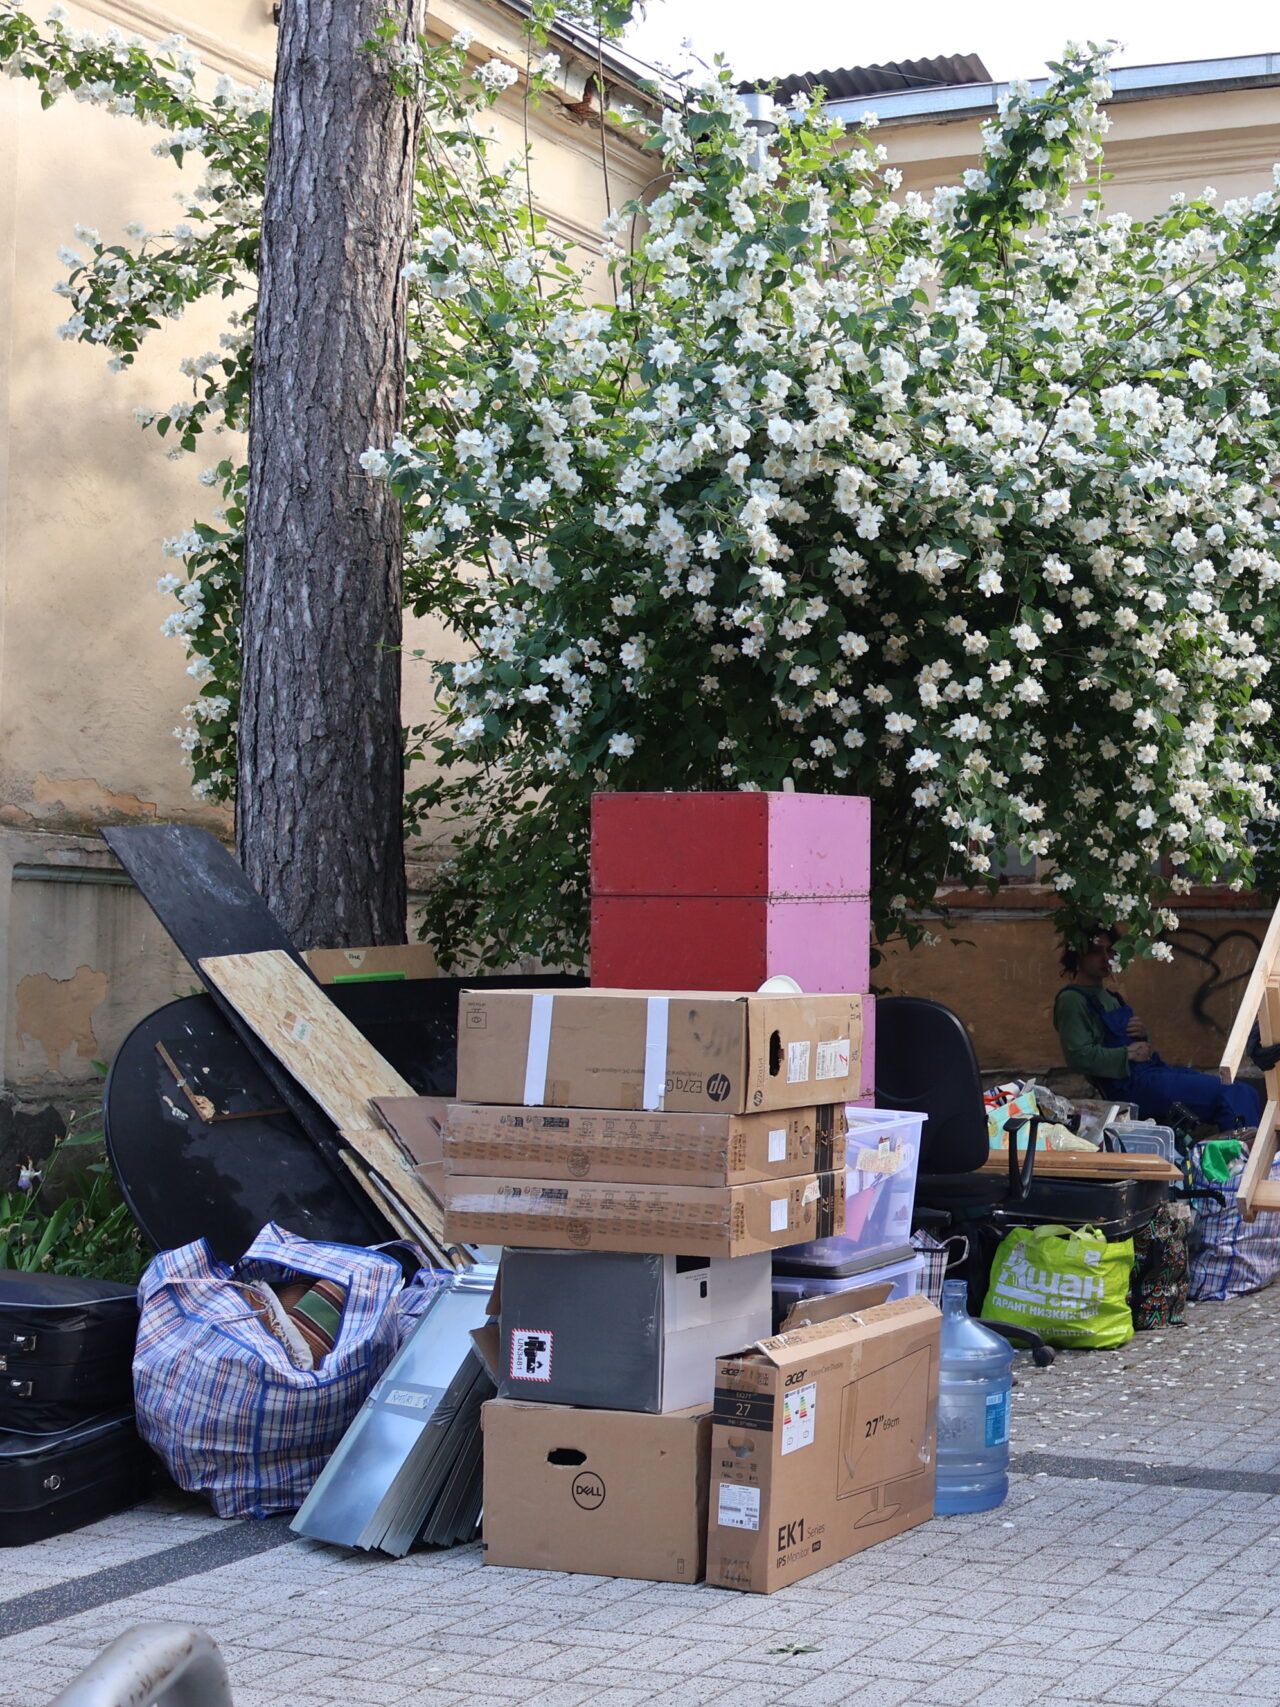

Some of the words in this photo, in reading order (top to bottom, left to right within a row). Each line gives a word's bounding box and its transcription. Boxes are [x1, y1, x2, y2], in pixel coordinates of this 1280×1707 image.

[707, 1073, 731, 1103] hp
[820, 1130, 829, 1146] 27
[822, 1197, 830, 1213] 27
[992, 1296, 1027, 1313] ГАРАНТ
[1029, 1305, 1077, 1320] НИЗКИХ
[516, 1338, 524, 1370] UN3481
[721, 1367, 744, 1377] acer
[784, 1369, 808, 1387] acer
[735, 1403, 751, 1416] 27
[576, 1485, 602, 1497] DELL
[777, 1518, 805, 1552] EK1
[806, 1523, 826, 1539] Series
[776, 1554, 787, 1569] IPS
[788, 1547, 810, 1564] Monitor
